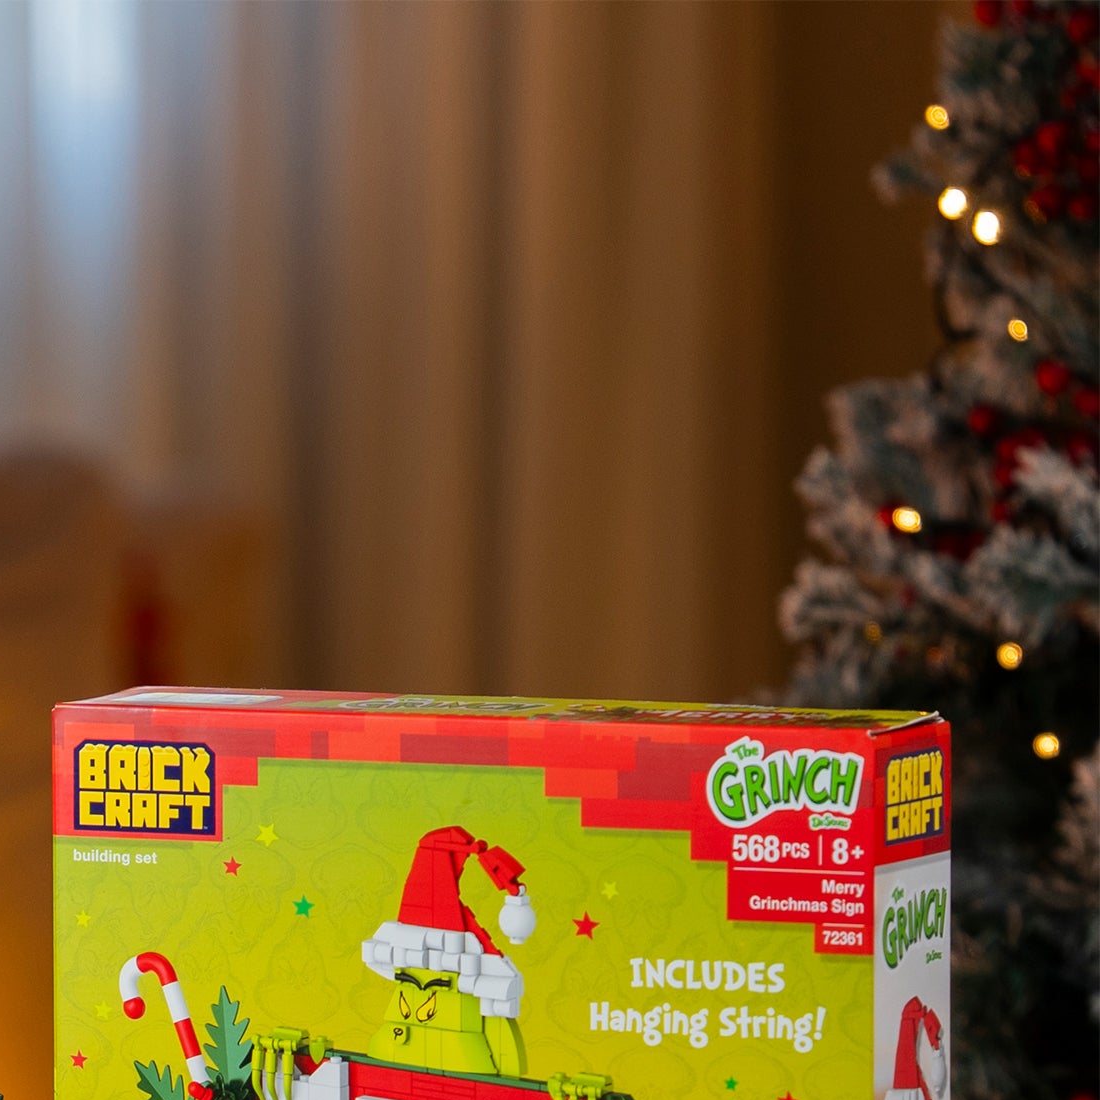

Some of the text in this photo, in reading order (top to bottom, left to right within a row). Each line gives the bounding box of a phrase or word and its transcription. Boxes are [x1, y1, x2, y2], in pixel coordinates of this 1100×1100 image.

[79, 743, 211, 793] BRICK
[731, 743, 759, 760] The
[712, 754, 859, 822] GRINCH
[886, 750, 943, 805] BRICK
[79, 791, 211, 830] CRAFT
[886, 796, 943, 842] CRAFT
[72, 849, 158, 866] building set
[831, 837, 865, 865] 8+
[749, 894, 865, 917] Grinchmas Sign
[821, 879, 866, 898] Merry
[822, 930, 864, 947] 72361
[882, 887, 948, 969] GRINCH
[630, 957, 786, 994] INCLUDES
[589, 1001, 827, 1053] Hanging String!
